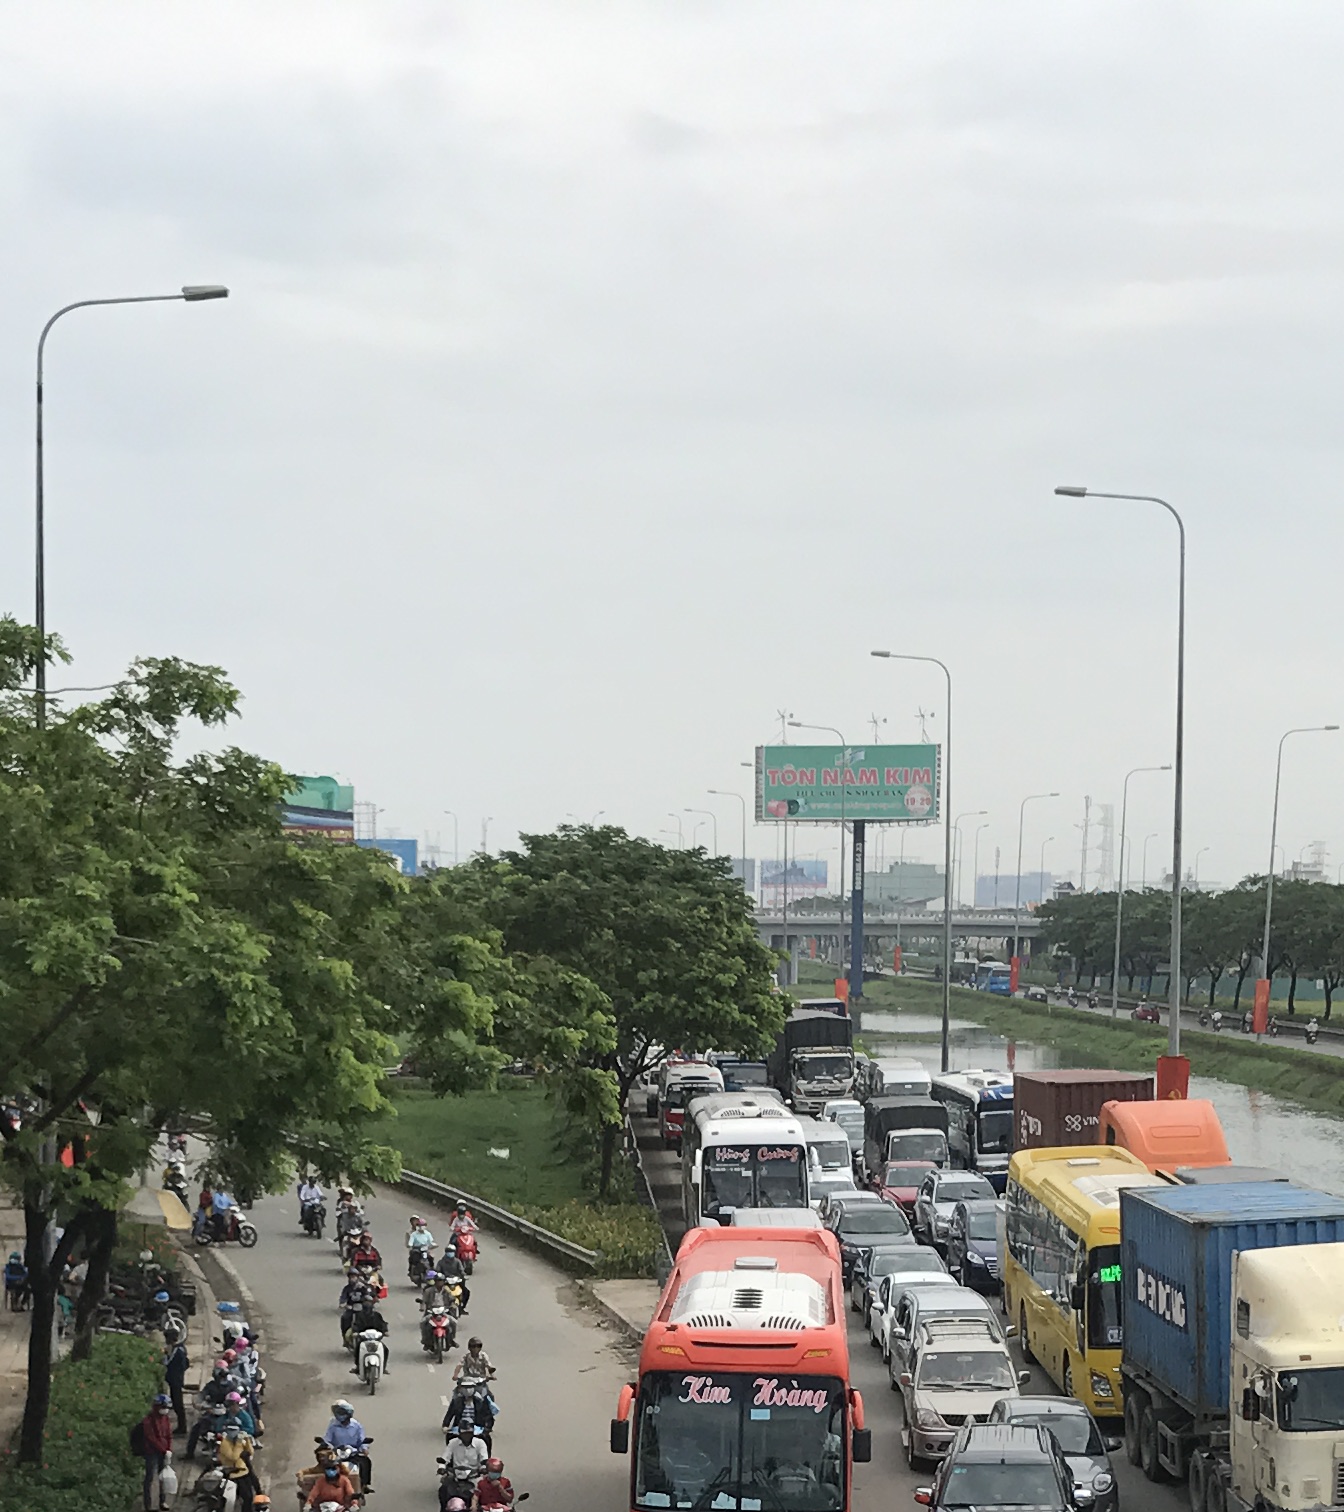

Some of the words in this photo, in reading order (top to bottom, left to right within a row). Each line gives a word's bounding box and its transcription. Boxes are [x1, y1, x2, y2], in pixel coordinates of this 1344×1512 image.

[767, 763, 816, 787] TÔN
[822, 767, 879, 787] NAM
[884, 767, 933, 787] KIM
[678, 1375, 732, 1404] Kim
[752, 1378, 829, 1414] Hoàng
